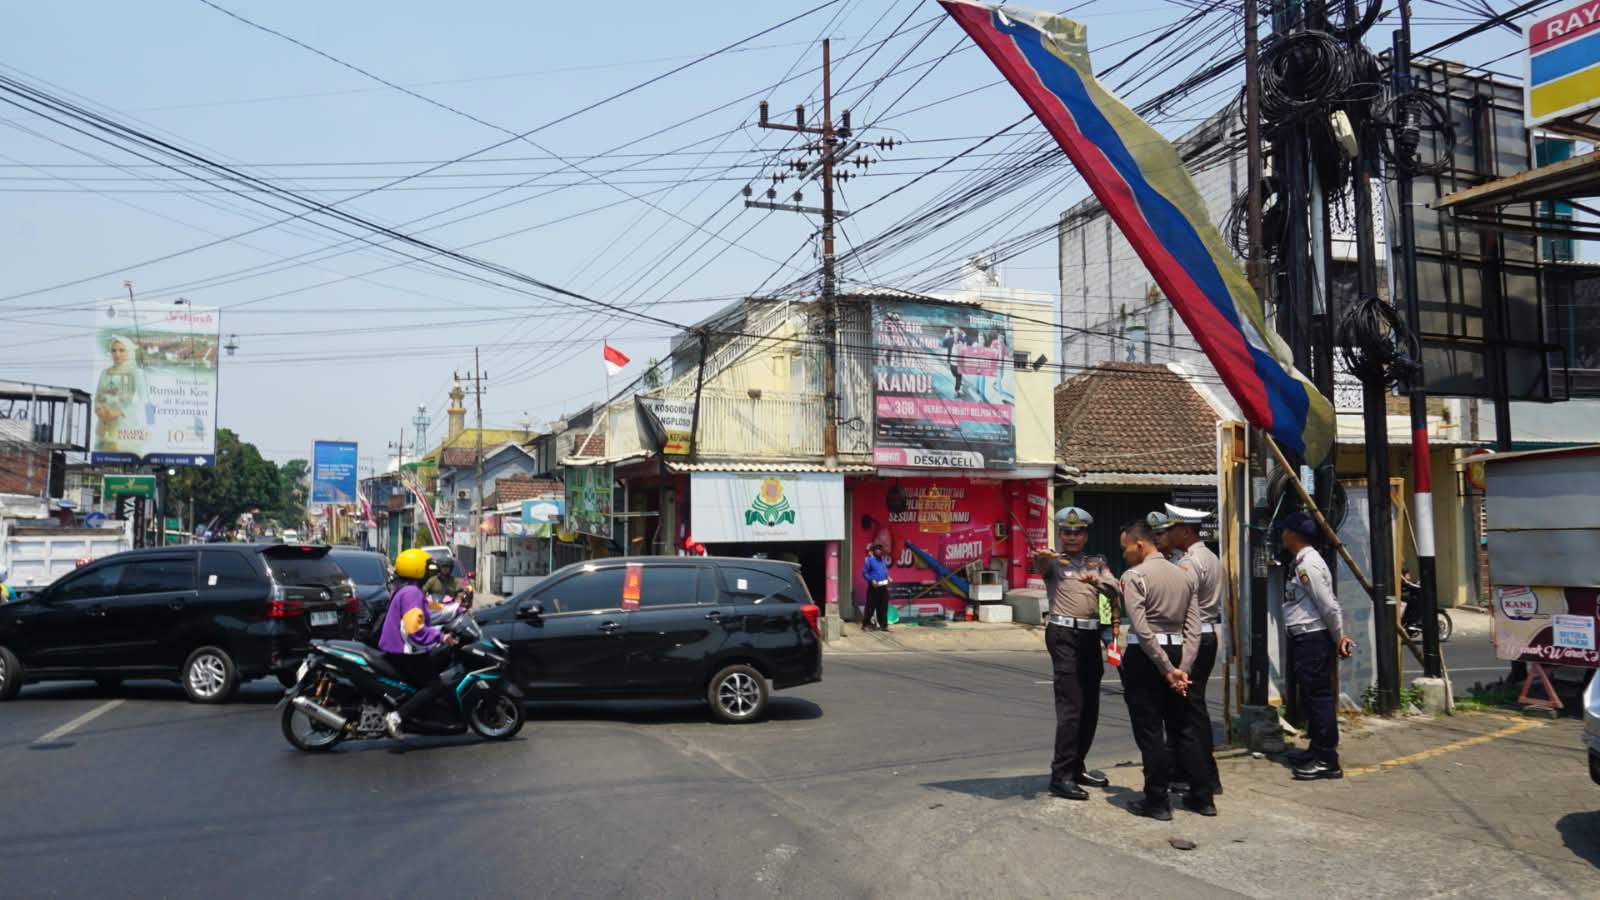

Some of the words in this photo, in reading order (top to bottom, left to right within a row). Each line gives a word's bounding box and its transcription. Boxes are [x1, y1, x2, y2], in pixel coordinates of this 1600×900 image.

[1547, 3, 1600, 40] RAY
[877, 372, 933, 393] KAMU!
[150, 386, 185, 396] Rumah
[152, 407, 209, 417] Ternyaman
[655, 404, 688, 414] KOSGORO
[914, 455, 949, 465] DESKA
[951, 457, 976, 468] CELL
[888, 512, 917, 522] SESUAI
[945, 540, 983, 561] SIMPATI
[1504, 600, 1534, 609] KANE
